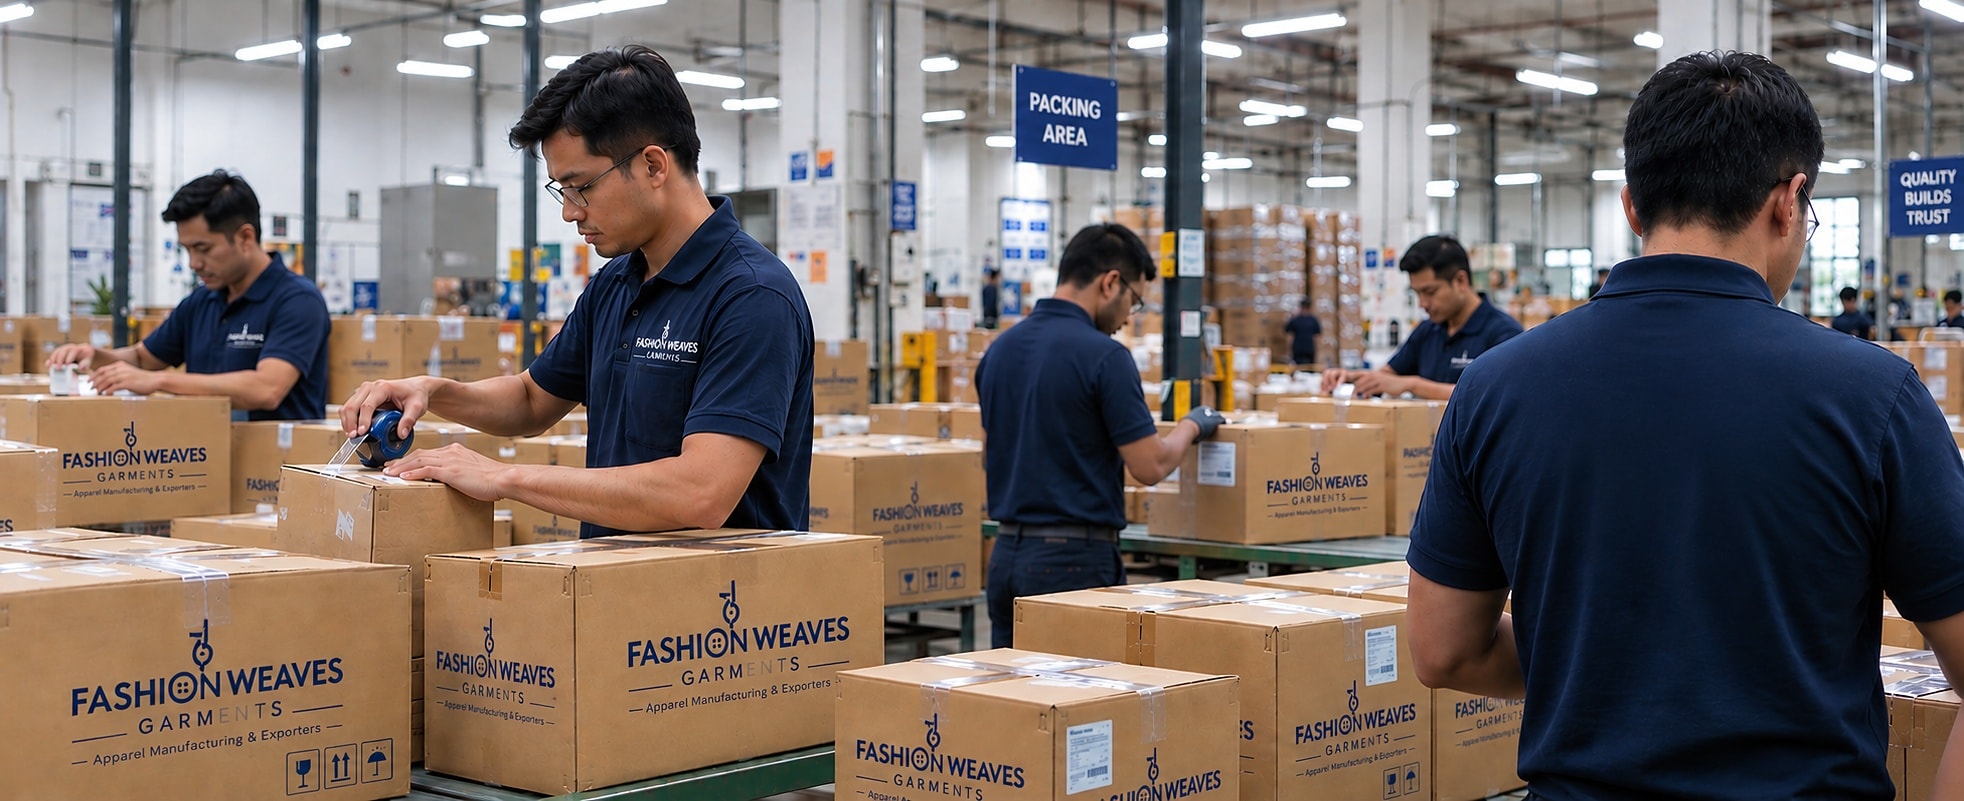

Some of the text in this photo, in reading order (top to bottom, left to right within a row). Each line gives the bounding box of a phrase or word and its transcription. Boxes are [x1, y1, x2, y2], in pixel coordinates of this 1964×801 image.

[1029, 91, 1101, 120] PACKING
[1042, 123, 1088, 147] AREA
[1900, 168, 1957, 188] QUALITY
[1905, 188, 1952, 206] BUILDS
[1906, 208, 1951, 226] TRUST
[63, 447, 207, 469] FASHION WEAVES
[97, 469, 174, 482] GARMENTS
[1266, 474, 1368, 494] FASHION WEAVES
[73, 483, 196, 498] Apparel Manufacturing & Exporters
[1291, 493, 1346, 506] GARMENTS
[873, 502, 964, 522] FASHION WEAVES
[893, 522, 943, 534] GARMENTS
[628, 616, 850, 668] FASHION WEAVES
[436, 650, 555, 688] FASHION WEAVES
[681, 656, 800, 686] GARMENTS
[71, 657, 344, 717] FASHION WEAVES
[462, 682, 524, 704] GARMENTS
[645, 679, 831, 715] Apparel Manufacturing & Exporters
[138, 700, 283, 735] GARMENTS
[1295, 703, 1416, 745] FASHION WEAVES
[93, 724, 322, 766] Apparel Manufacturing & Exporters
[1325, 733, 1390, 756] GARMENTS
[856, 739, 1025, 789] FASHION WEAVES
[1305, 747, 1407, 777] Apparel Manufacturing & Exporters
[893, 773, 983, 801] GARMENTS
[1165, 769, 1221, 799] WEAVES
